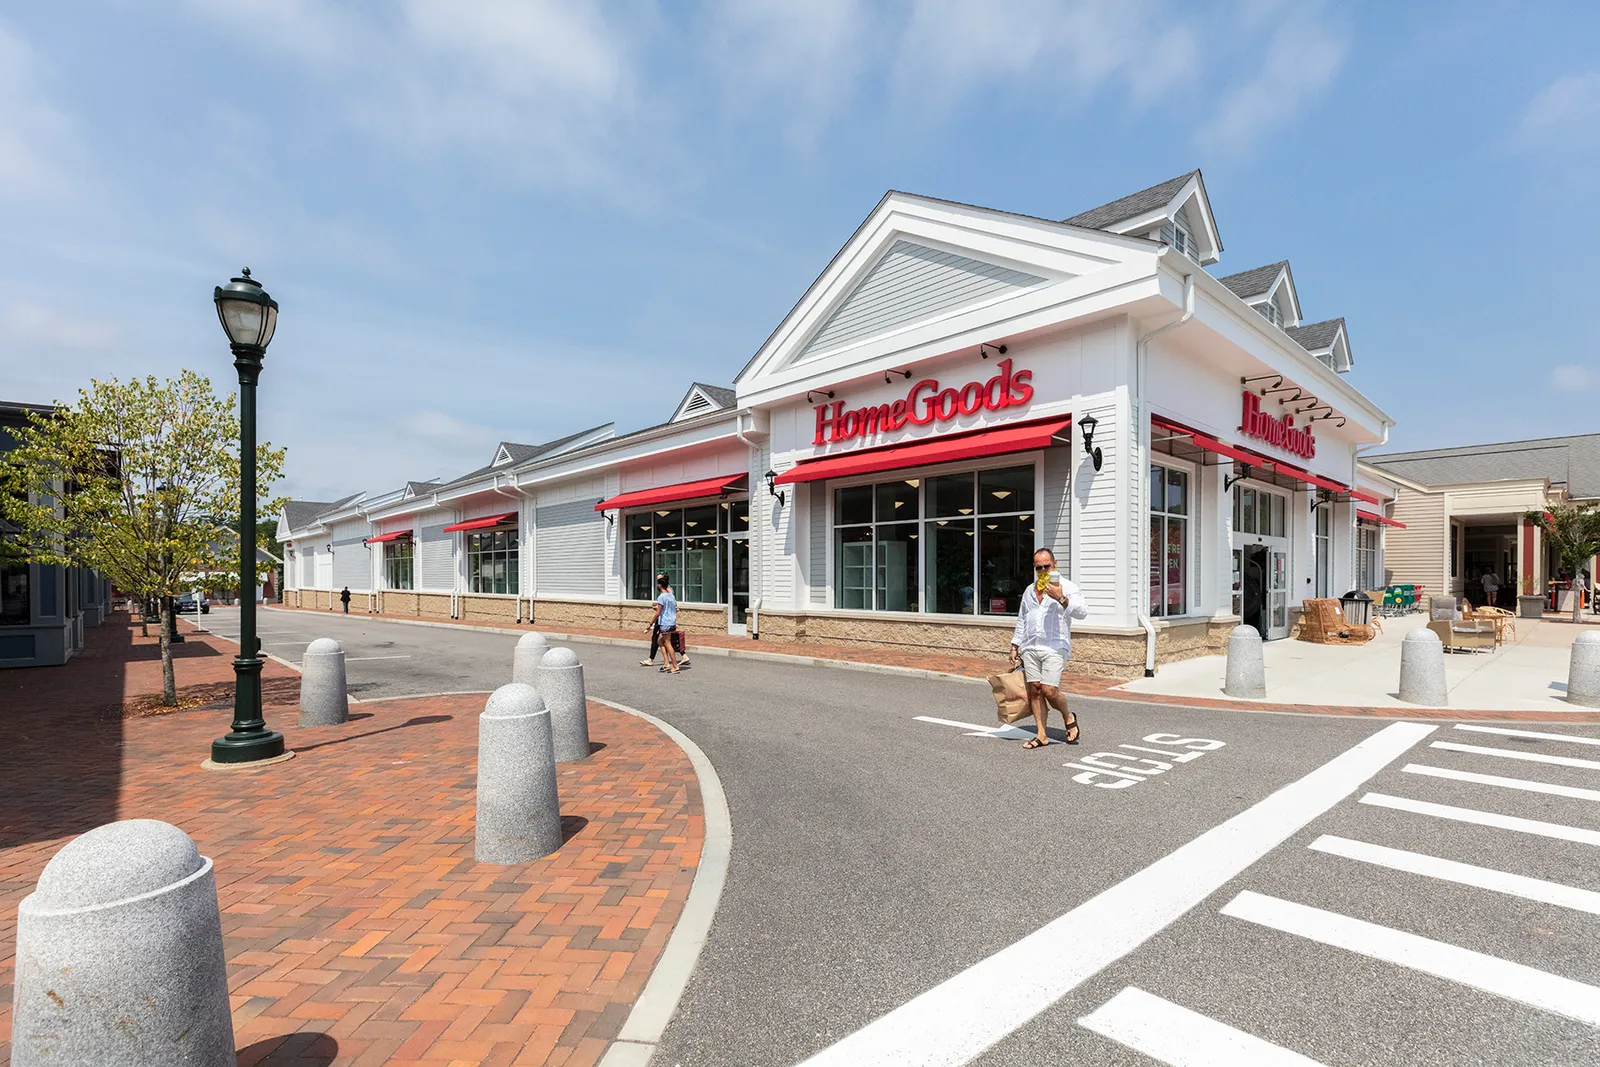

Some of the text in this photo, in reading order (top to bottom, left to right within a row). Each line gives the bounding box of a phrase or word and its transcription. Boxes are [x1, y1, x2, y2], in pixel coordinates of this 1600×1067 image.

[812, 358, 1034, 445] HomeGoods
[1241, 391, 1316, 459] HomeGoods
[1062, 733, 1226, 789] STOP
